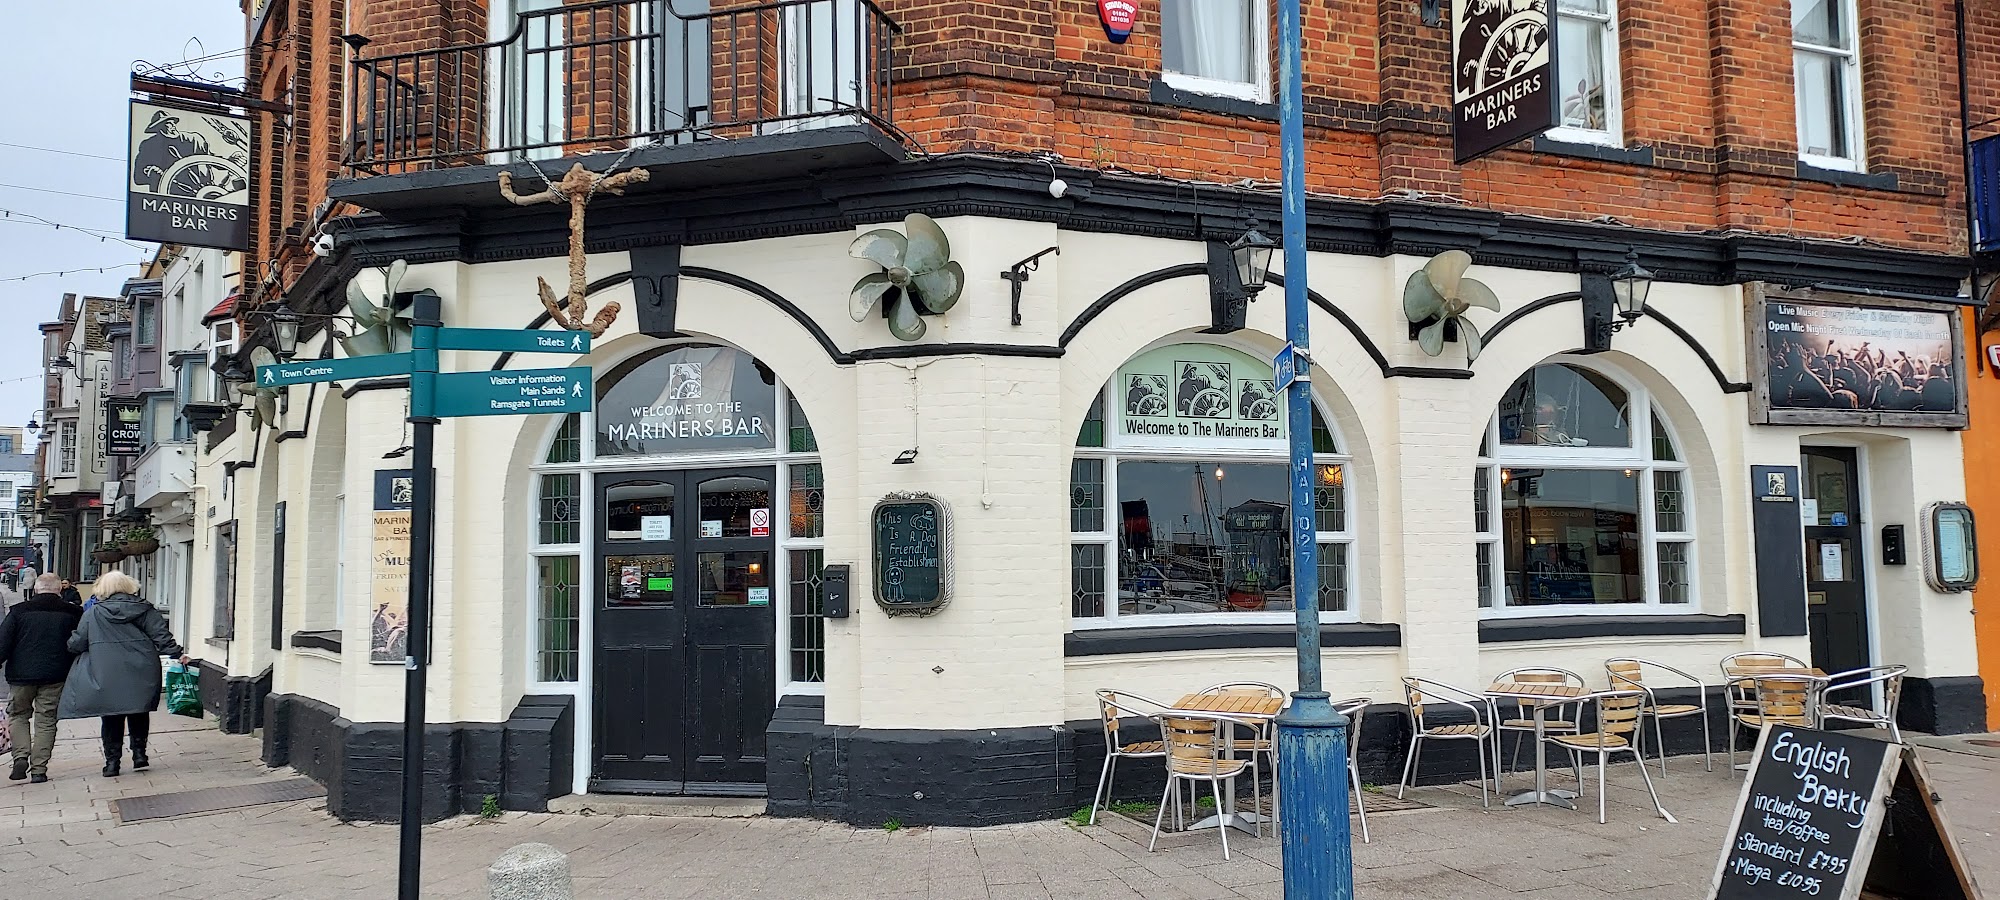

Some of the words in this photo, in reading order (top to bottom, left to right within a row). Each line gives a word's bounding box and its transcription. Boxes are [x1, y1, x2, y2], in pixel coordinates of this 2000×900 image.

[1464, 73, 1541, 122] MARINERS
[1486, 104, 1517, 131] BAR
[141, 197, 238, 222] MARINERS
[171, 215, 209, 232] BAR
[1778, 304, 1795, 316] Live
[1796, 306, 1819, 318] Music
[1821, 308, 1843, 321] Every
[1845, 309, 1869, 323] Friday
[1878, 312, 1911, 325] Saturday
[1913, 314, 1936, 326] Night
[1768, 320, 1790, 333] Open
[1790, 321, 1805, 333] Mic
[1806, 323, 1828, 337] Night
[1828, 325, 1847, 336] First
[1848, 326, 1891, 340] Wednesday
[537, 336, 566, 348] Toilets
[280, 368, 302, 379] Town
[303, 366, 334, 377] Centre
[490, 375, 516, 386] Visitor
[518, 374, 566, 385] Information
[99, 363, 109, 417] ALBERT
[520, 386, 541, 396] Main
[543, 385, 566, 396] Sands
[491, 399, 531, 411] Ramsgate
[532, 397, 566, 408] Tunnels
[631, 403, 692, 418] WELCOME
[695, 403, 713, 416] TO
[716, 401, 742, 414] THE
[112, 429, 140, 439] CROW
[608, 418, 714, 442] MARINERS
[722, 415, 765, 437] BAR
[1126, 418, 1175, 435] Welcome
[1178, 421, 1189, 435] to
[1192, 420, 1212, 436] The
[1215, 422, 1259, 438] Mariners
[1262, 424, 1279, 438] Bar
[97, 423, 107, 469] COURT
[374, 516, 410, 525] MARIN
[882, 512, 902, 525] This
[393, 527, 411, 535] BA
[889, 526, 899, 540] Is
[909, 531, 916, 542] A
[921, 530, 937, 547] Dog
[374, 547, 394, 563] LIVE
[889, 541, 928, 559] Friendly
[384, 556, 411, 566] MUS
[1771, 731, 1850, 779] English
[1754, 793, 1812, 825] including
[1797, 774, 1870, 829] Brekky
[1763, 813, 1830, 844] tea/coffee
[1808, 850, 1849, 875] £7.95
[1735, 857, 1772, 885] Mega
[1777, 871, 1822, 896] £10.95
